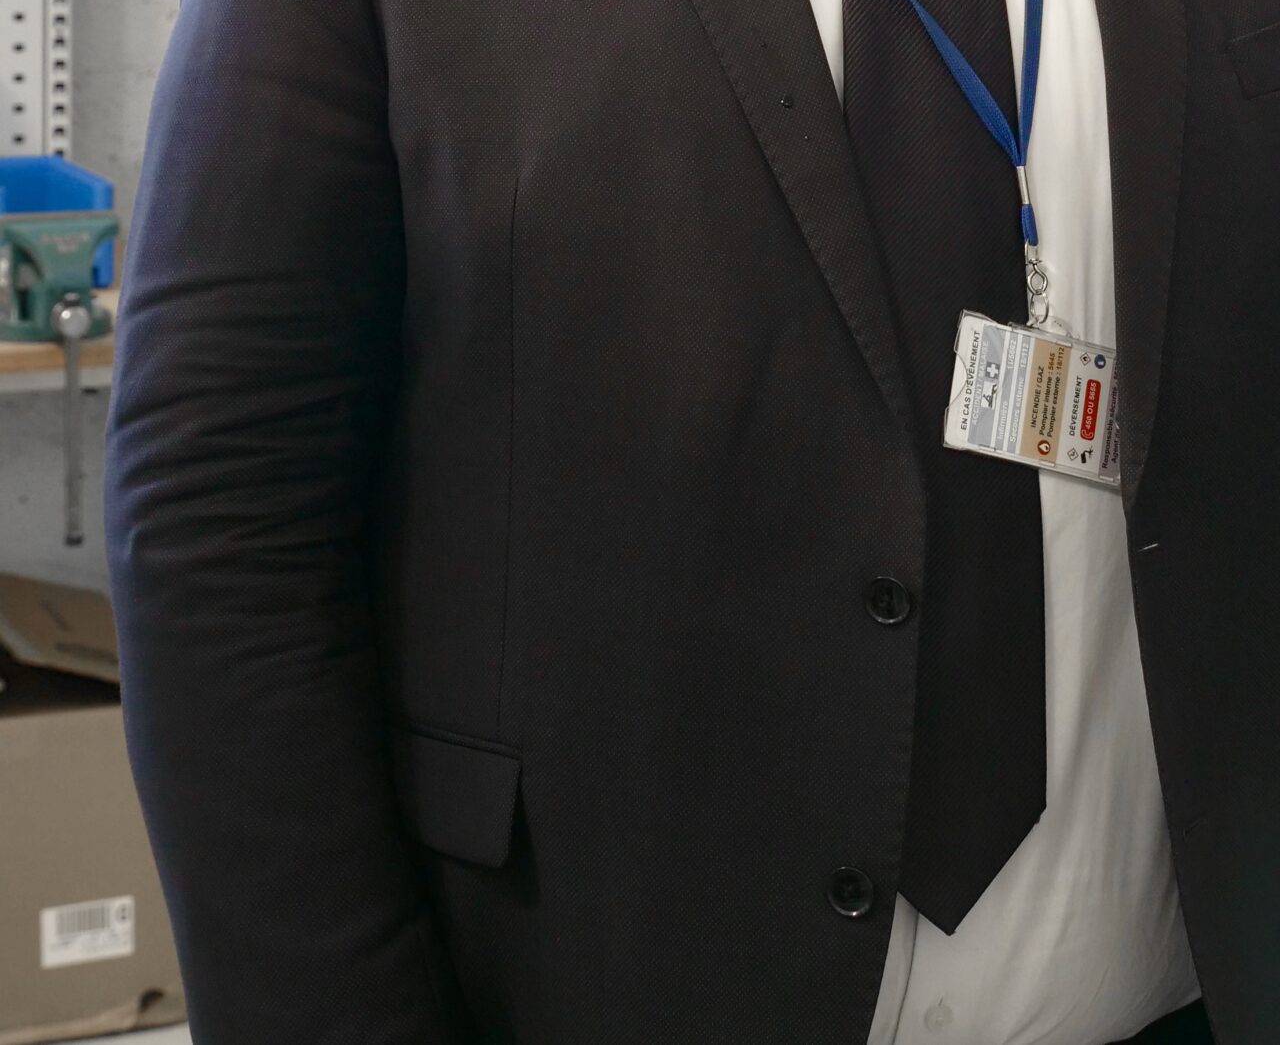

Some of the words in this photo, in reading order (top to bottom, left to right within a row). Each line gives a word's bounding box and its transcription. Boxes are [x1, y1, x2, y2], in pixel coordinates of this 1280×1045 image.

[963, 397, 971, 416] CAS
[1031, 389, 1041, 428] INCENDIE
[1037, 366, 1045, 383] GAZ
[1069, 376, 1082, 436] DÉVERSEMENT
[1087, 402, 1094, 415] OU
[961, 418, 968, 430] EN
[1010, 410, 1020, 442] Secours
[1039, 404, 1049, 436] Pompier
[1047, 406, 1057, 437] Pompier
[1102, 420, 1113, 469] Responsable
